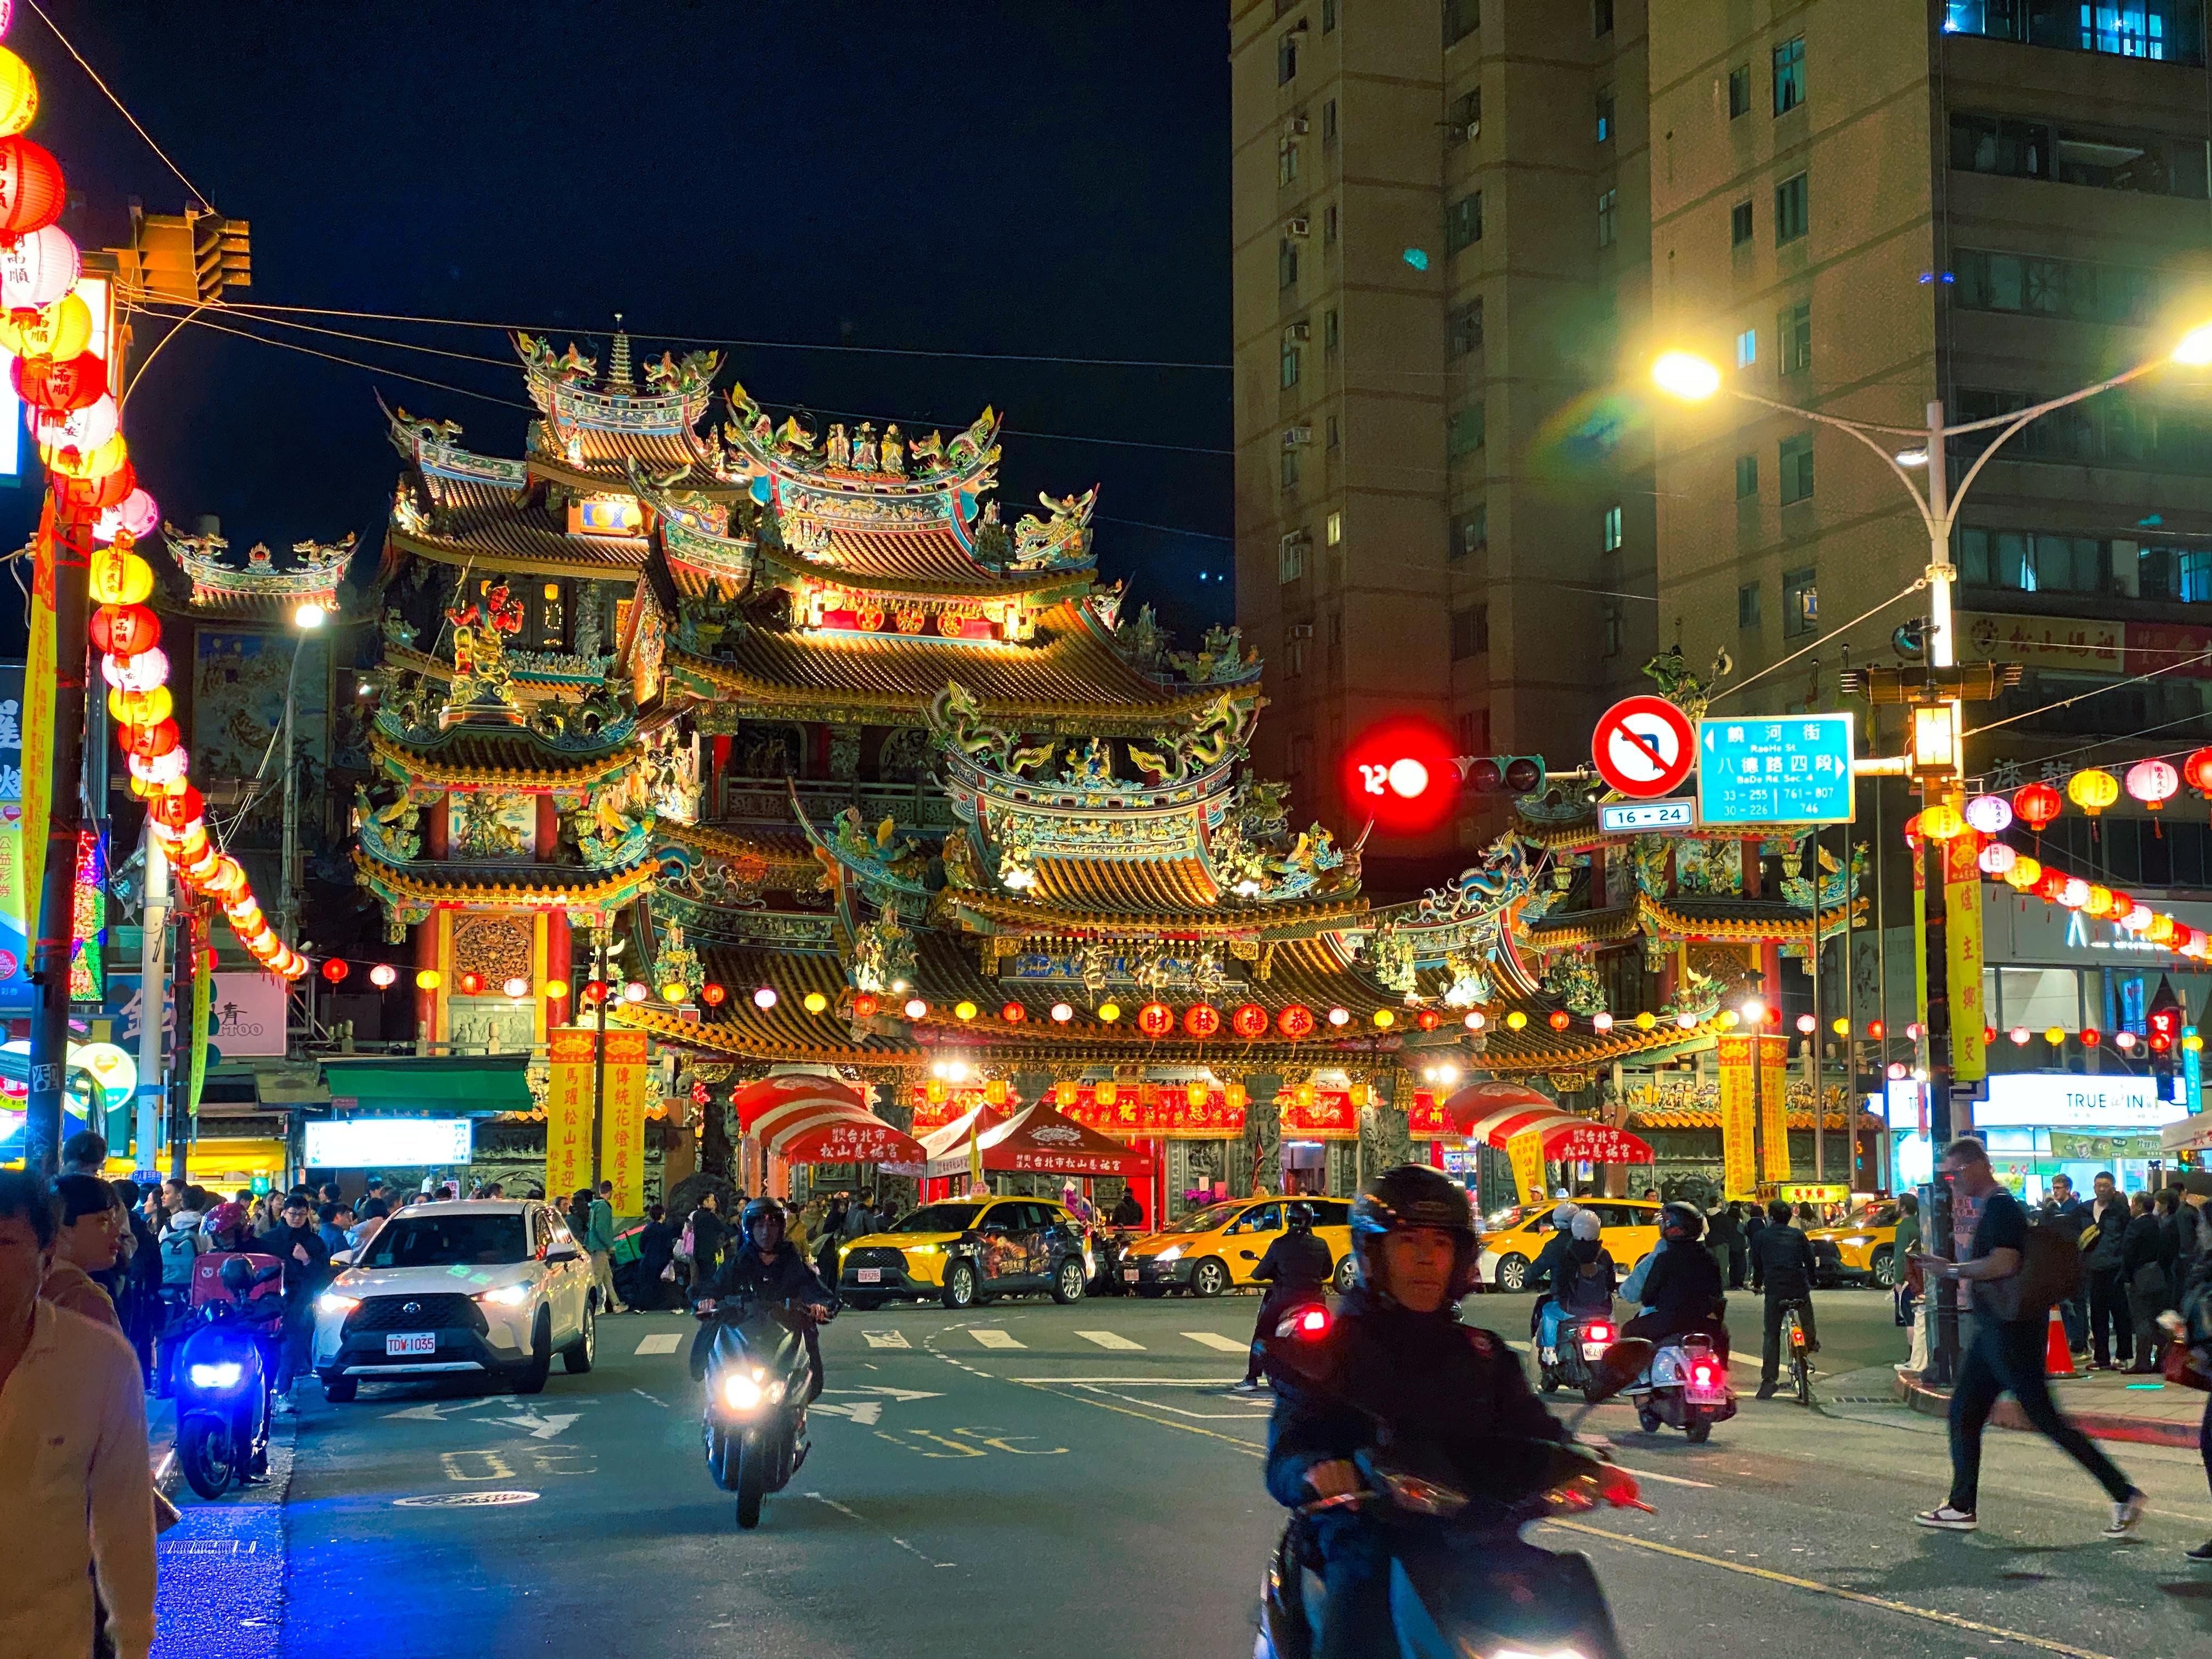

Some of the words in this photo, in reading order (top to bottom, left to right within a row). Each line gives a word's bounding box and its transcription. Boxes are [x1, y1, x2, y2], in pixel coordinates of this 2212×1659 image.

[1727, 723, 1821, 743] 饒河街
[1718, 754, 1832, 774] 八德路四段
[2067, 1093, 2107, 1108] TRUE
[613, 1066, 631, 1211] 傳統花燈慶元宵
